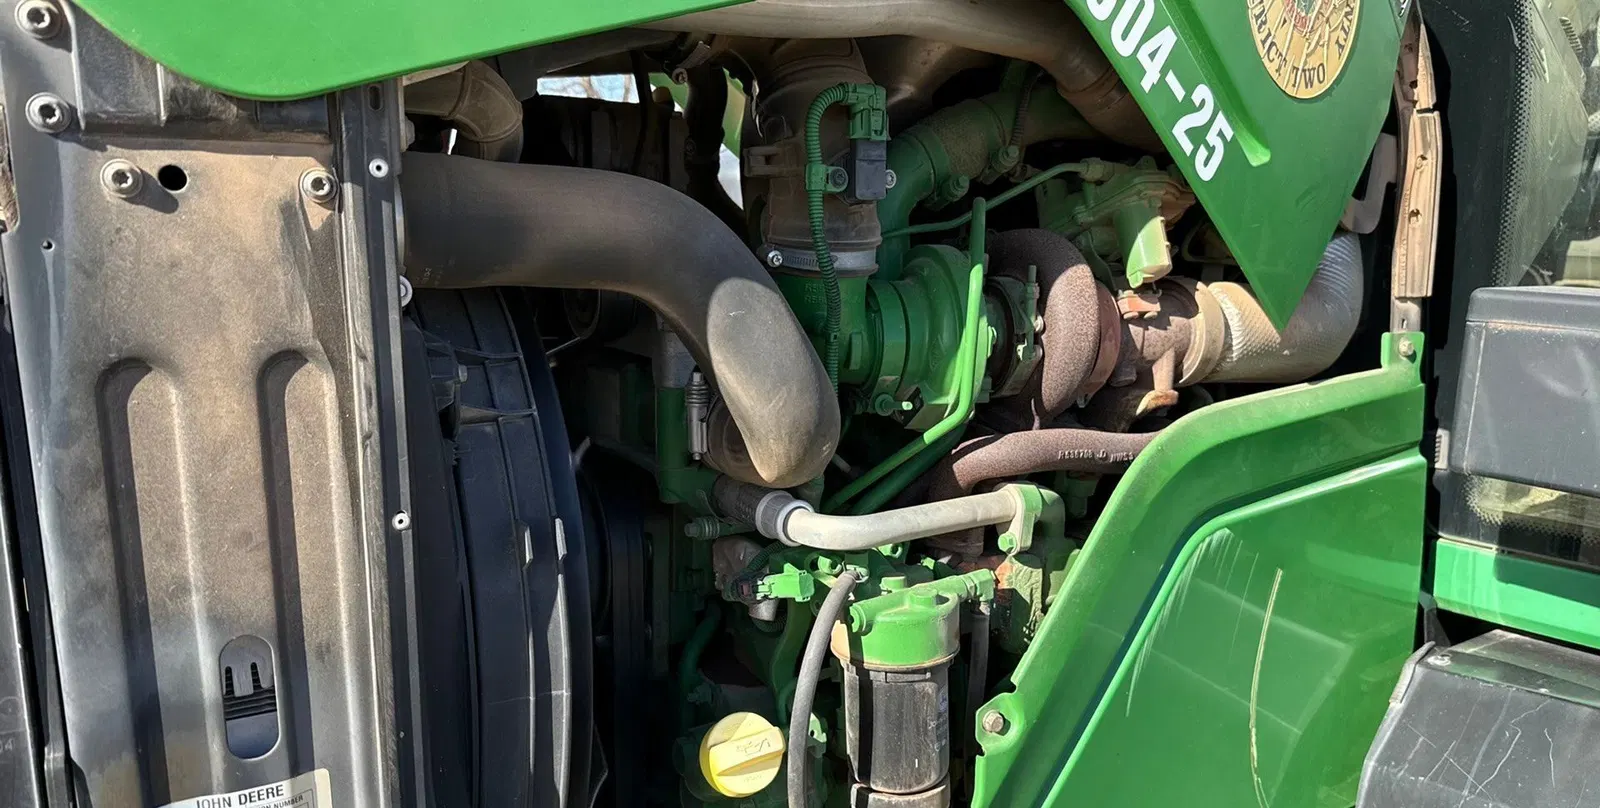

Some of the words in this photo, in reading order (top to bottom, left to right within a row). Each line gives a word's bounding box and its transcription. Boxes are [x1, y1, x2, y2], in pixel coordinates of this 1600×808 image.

[1250, 0, 1288, 76] RICT
[1291, 62, 1326, 89] TWO
[196, 796, 232, 808] JOHN
[238, 784, 284, 806] DEERE
[273, 794, 304, 808] NUMBER
